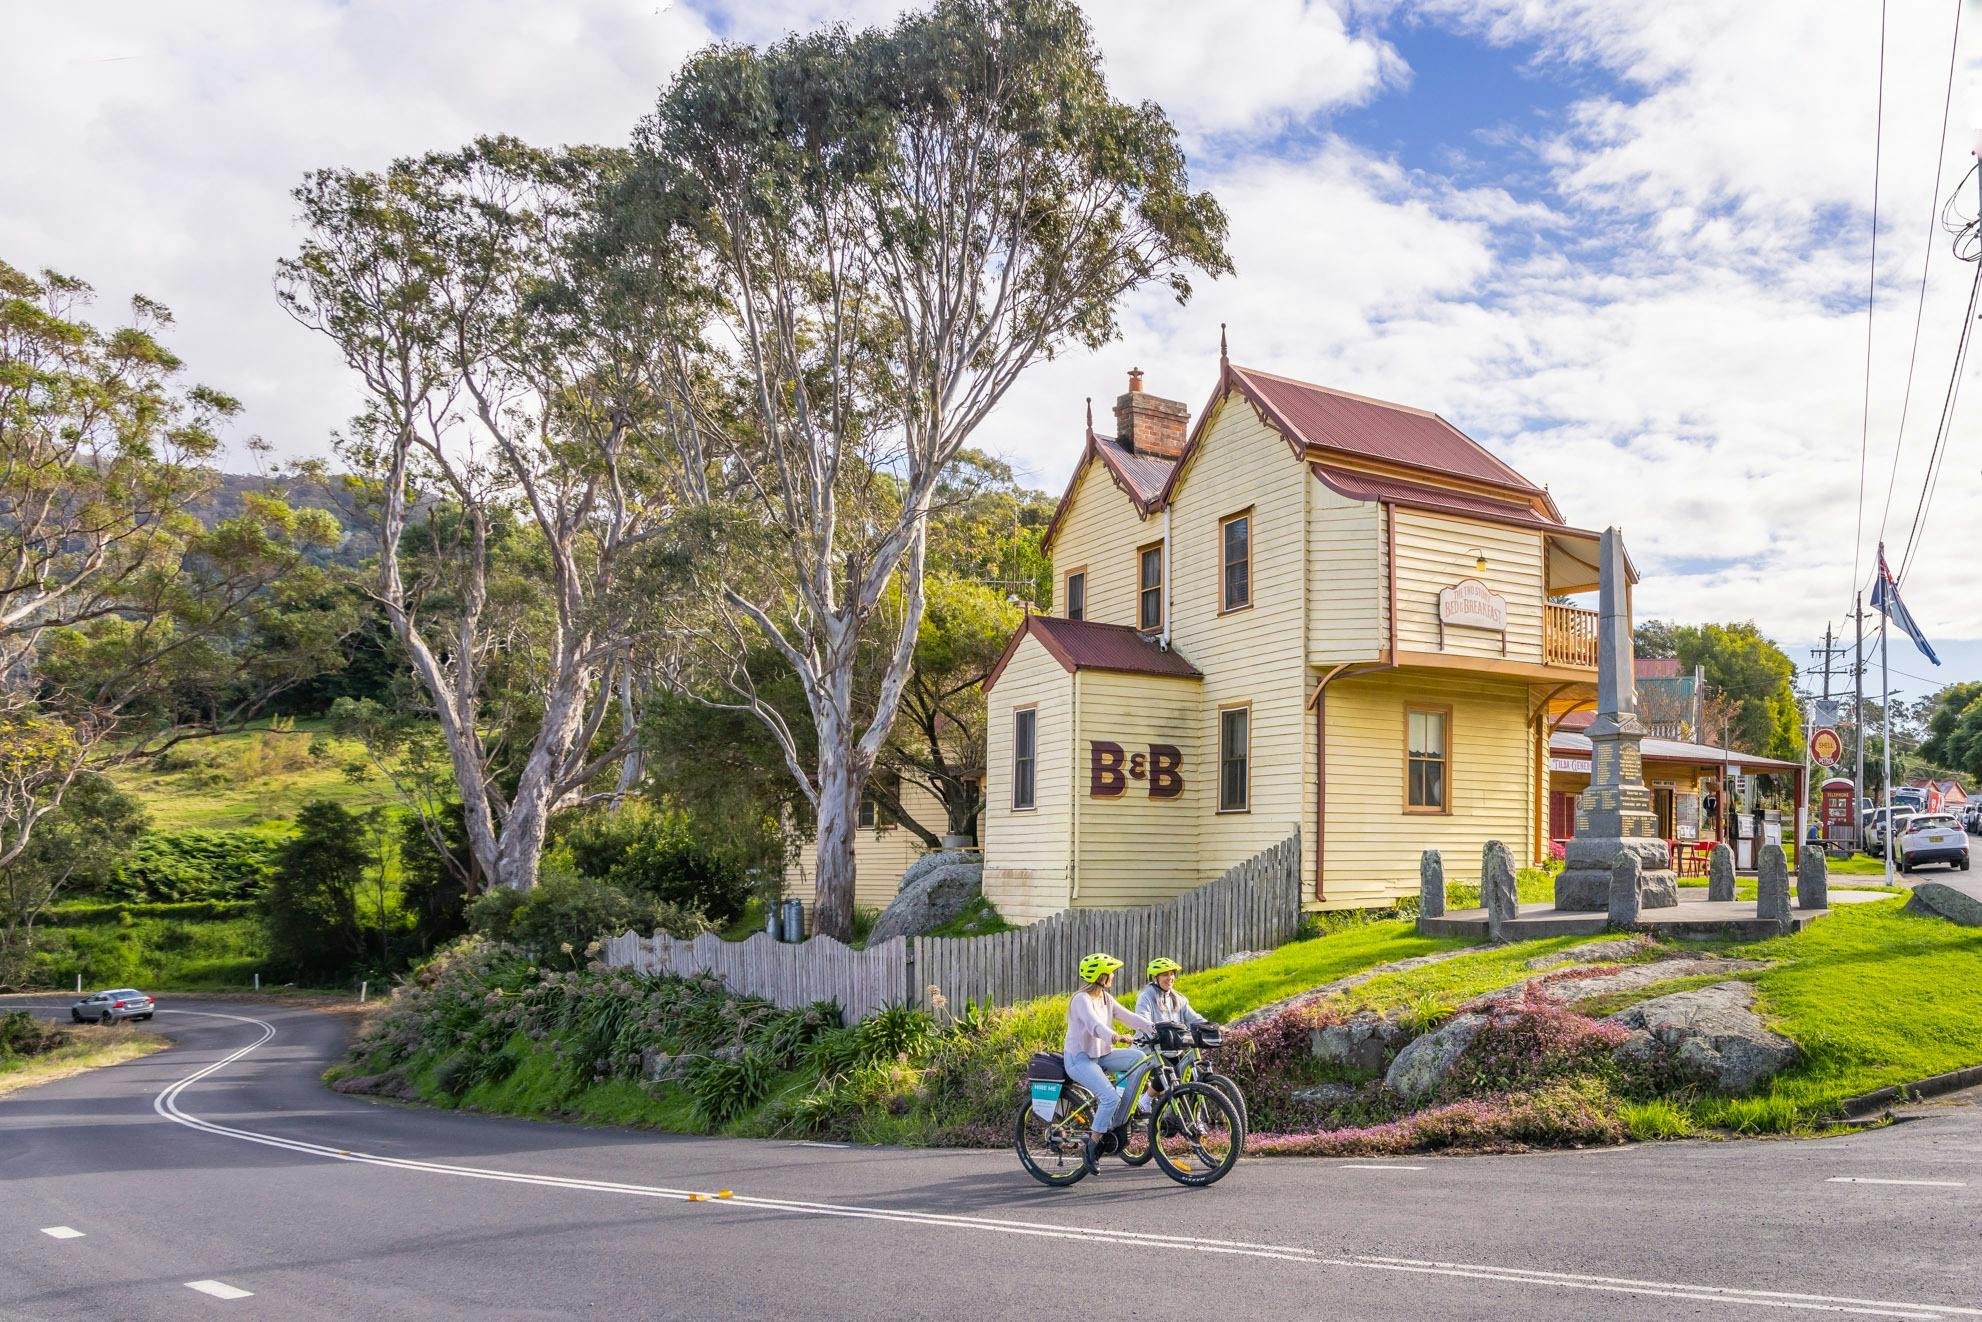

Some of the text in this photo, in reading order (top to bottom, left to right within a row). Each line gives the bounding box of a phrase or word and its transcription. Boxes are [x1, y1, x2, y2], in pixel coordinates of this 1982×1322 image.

[1445, 600, 1459, 617] BED
[1464, 598, 1501, 624] BREAKFAST
[1090, 740, 1185, 802] B&B
[1571, 760, 1592, 772] GENER
